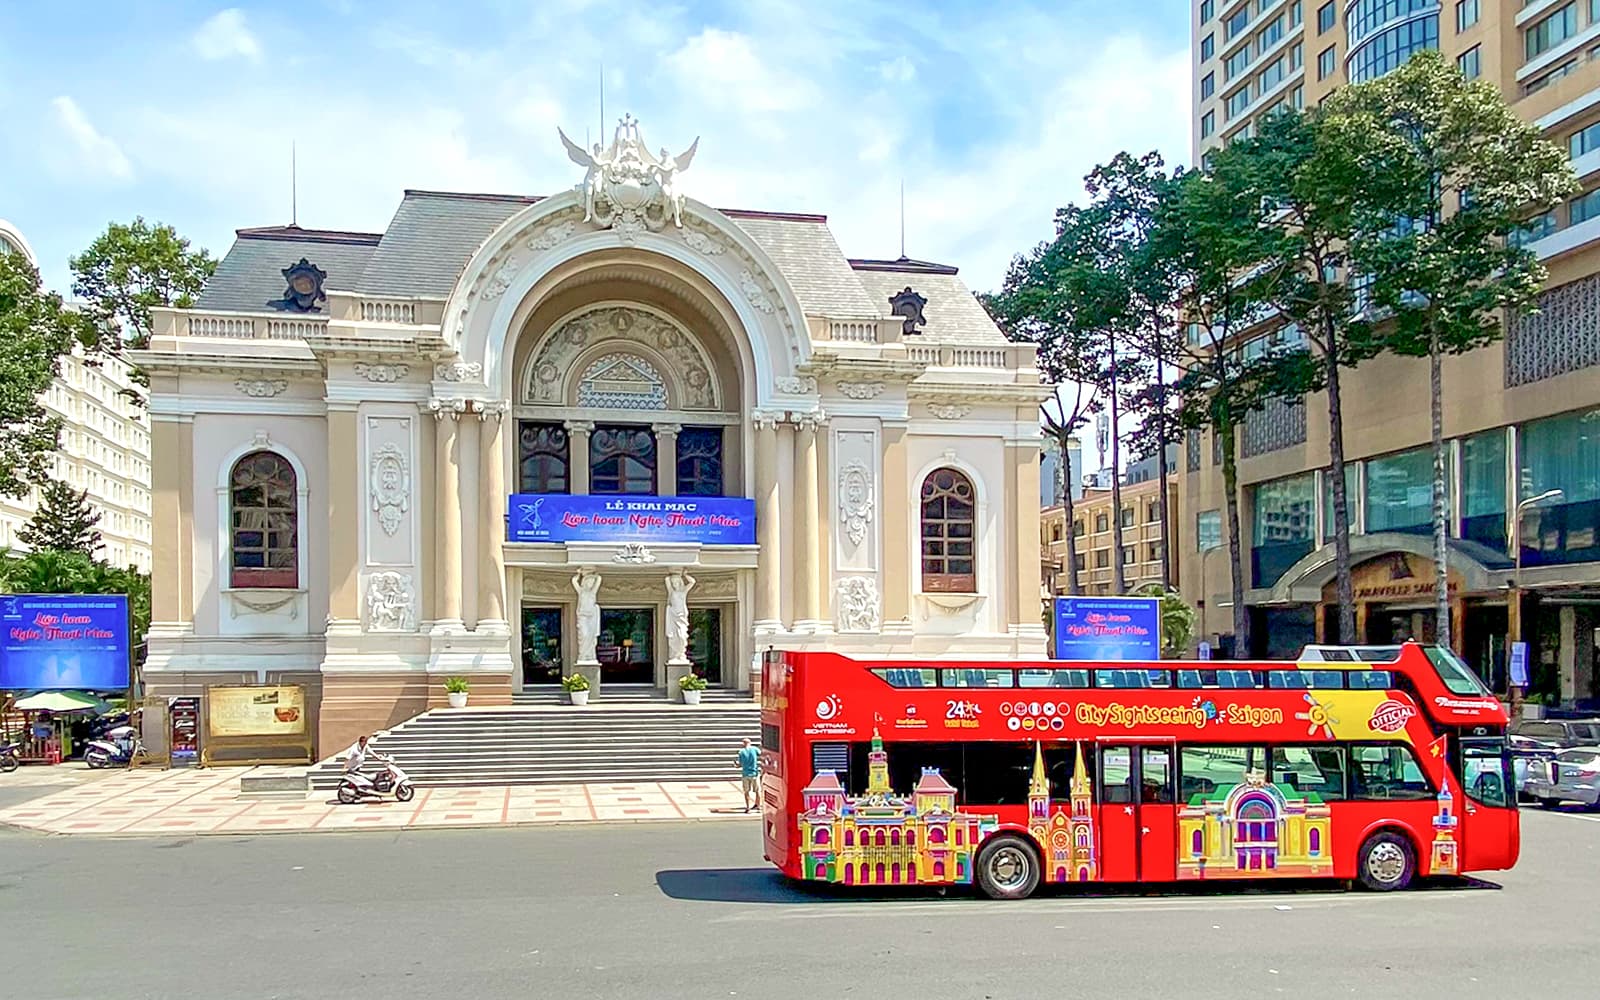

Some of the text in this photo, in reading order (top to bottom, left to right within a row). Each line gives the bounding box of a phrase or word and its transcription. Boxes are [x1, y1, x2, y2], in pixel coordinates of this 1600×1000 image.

[627, 502, 661, 511] KHAI
[592, 512, 625, 526] hoan
[1226, 703, 1284, 728] Saigon
[1370, 706, 1413, 729] OFFICIAL
